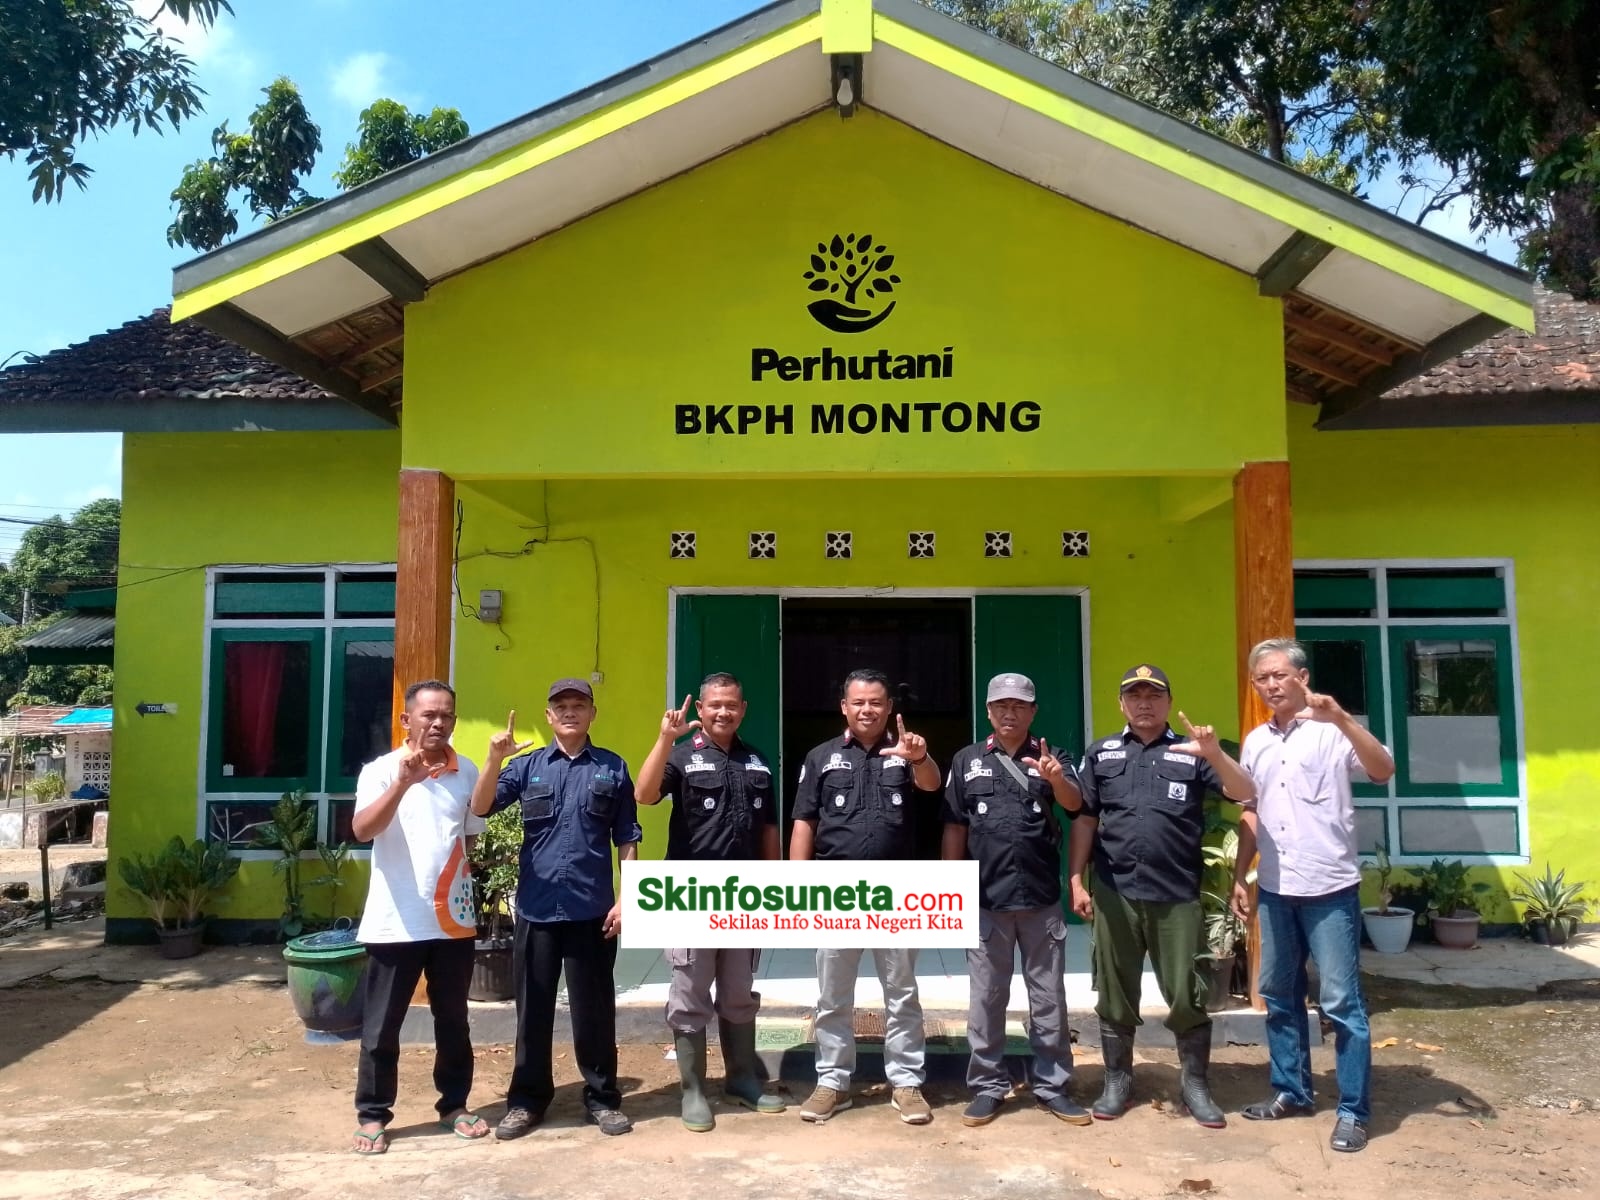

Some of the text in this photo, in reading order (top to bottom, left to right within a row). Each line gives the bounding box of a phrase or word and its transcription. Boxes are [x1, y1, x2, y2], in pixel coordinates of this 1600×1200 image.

[751, 346, 954, 382] Perhutani
[675, 401, 1042, 435] BKPH MONTONG
